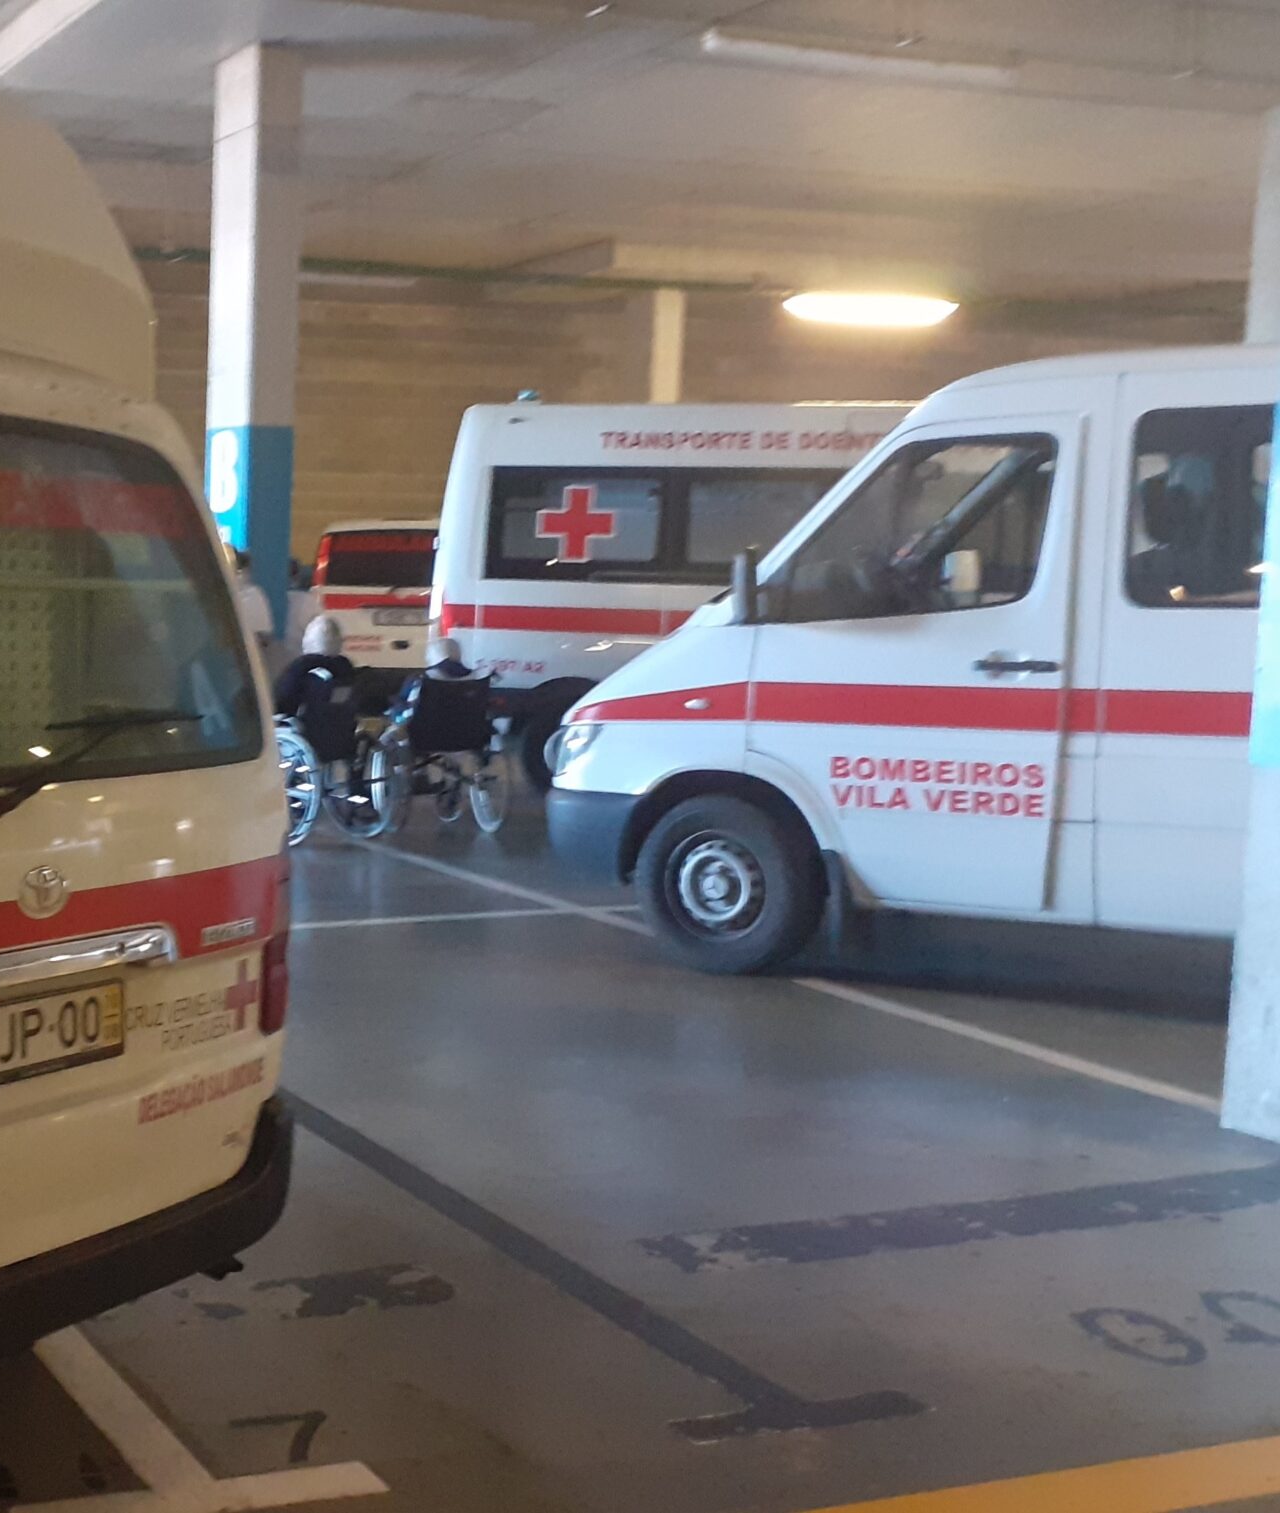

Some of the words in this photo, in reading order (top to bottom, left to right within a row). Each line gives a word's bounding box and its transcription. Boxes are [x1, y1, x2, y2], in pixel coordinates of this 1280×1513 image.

[600, 431, 751, 449] TRANSPORTE
[761, 431, 789, 449] DE
[799, 431, 885, 449] DOENT
[210, 430, 238, 513] B
[829, 756, 1045, 788] BOMBEIROS
[831, 784, 911, 811] VILA
[923, 789, 1044, 818] VERDE
[124, 1001, 164, 1031] CRUZ
